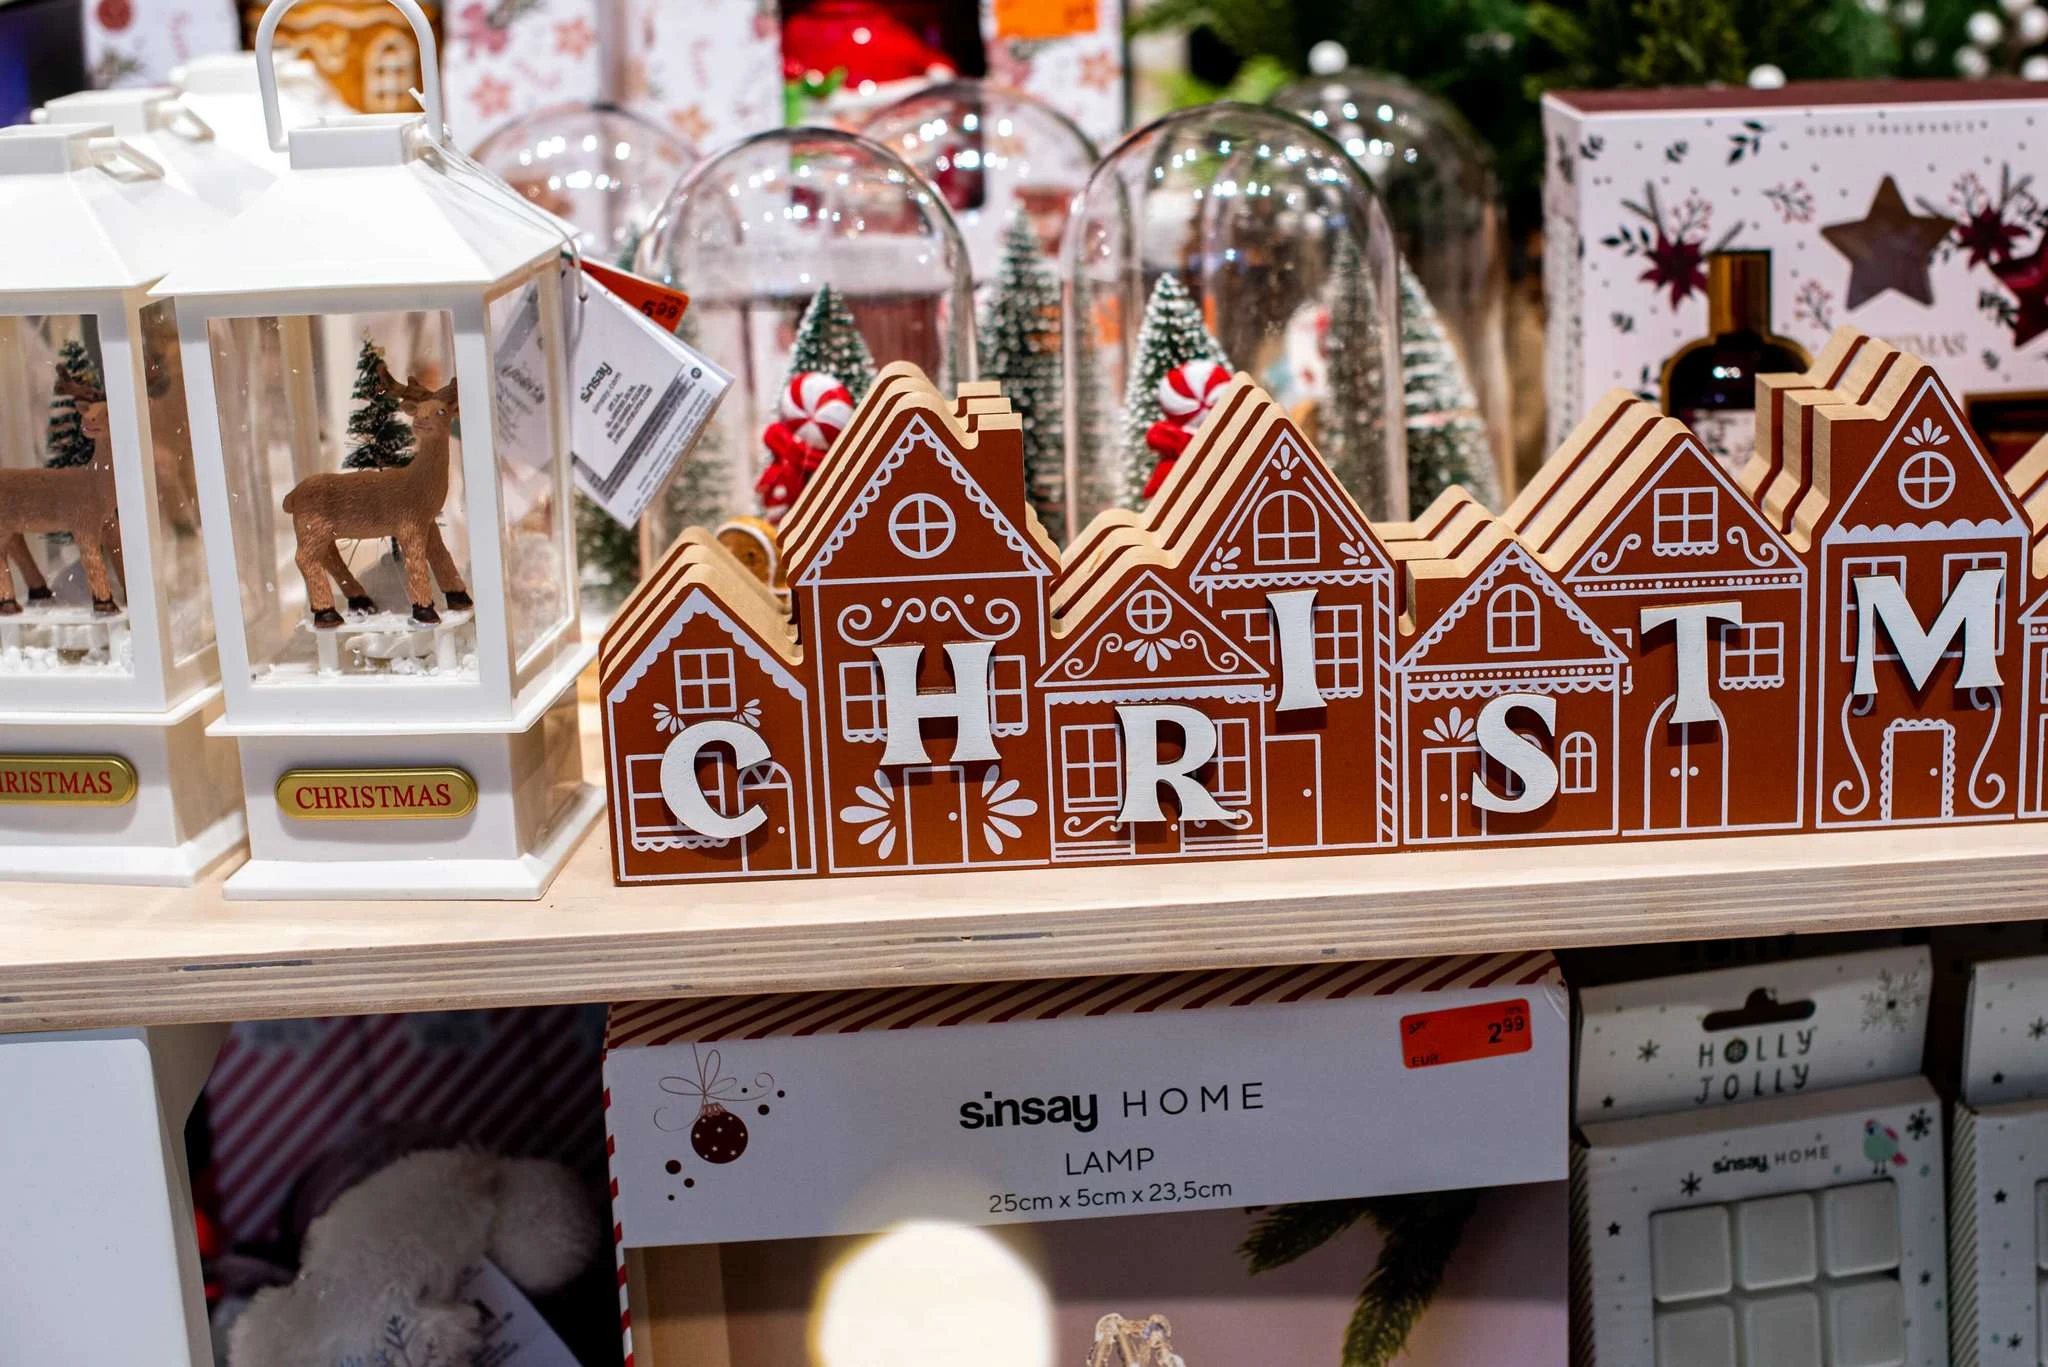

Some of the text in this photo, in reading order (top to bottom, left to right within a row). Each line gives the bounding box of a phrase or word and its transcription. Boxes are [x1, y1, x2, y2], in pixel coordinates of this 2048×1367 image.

[580, 361, 613, 404] sinsay
[0, 770, 113, 794] RISTMAS
[295, 783, 452, 810] CHRISTMAS
[1698, 1026, 1818, 1069] HOLLY
[1695, 1063, 1809, 1104] JOLLY
[959, 1082, 1264, 1133] sinsay HOME
[1066, 1148, 1155, 1176] LAMP
[1713, 1145, 1829, 1174] sinsay HOME
[989, 1181, 1232, 1213] 25cm x 5cm x 23,5cm
